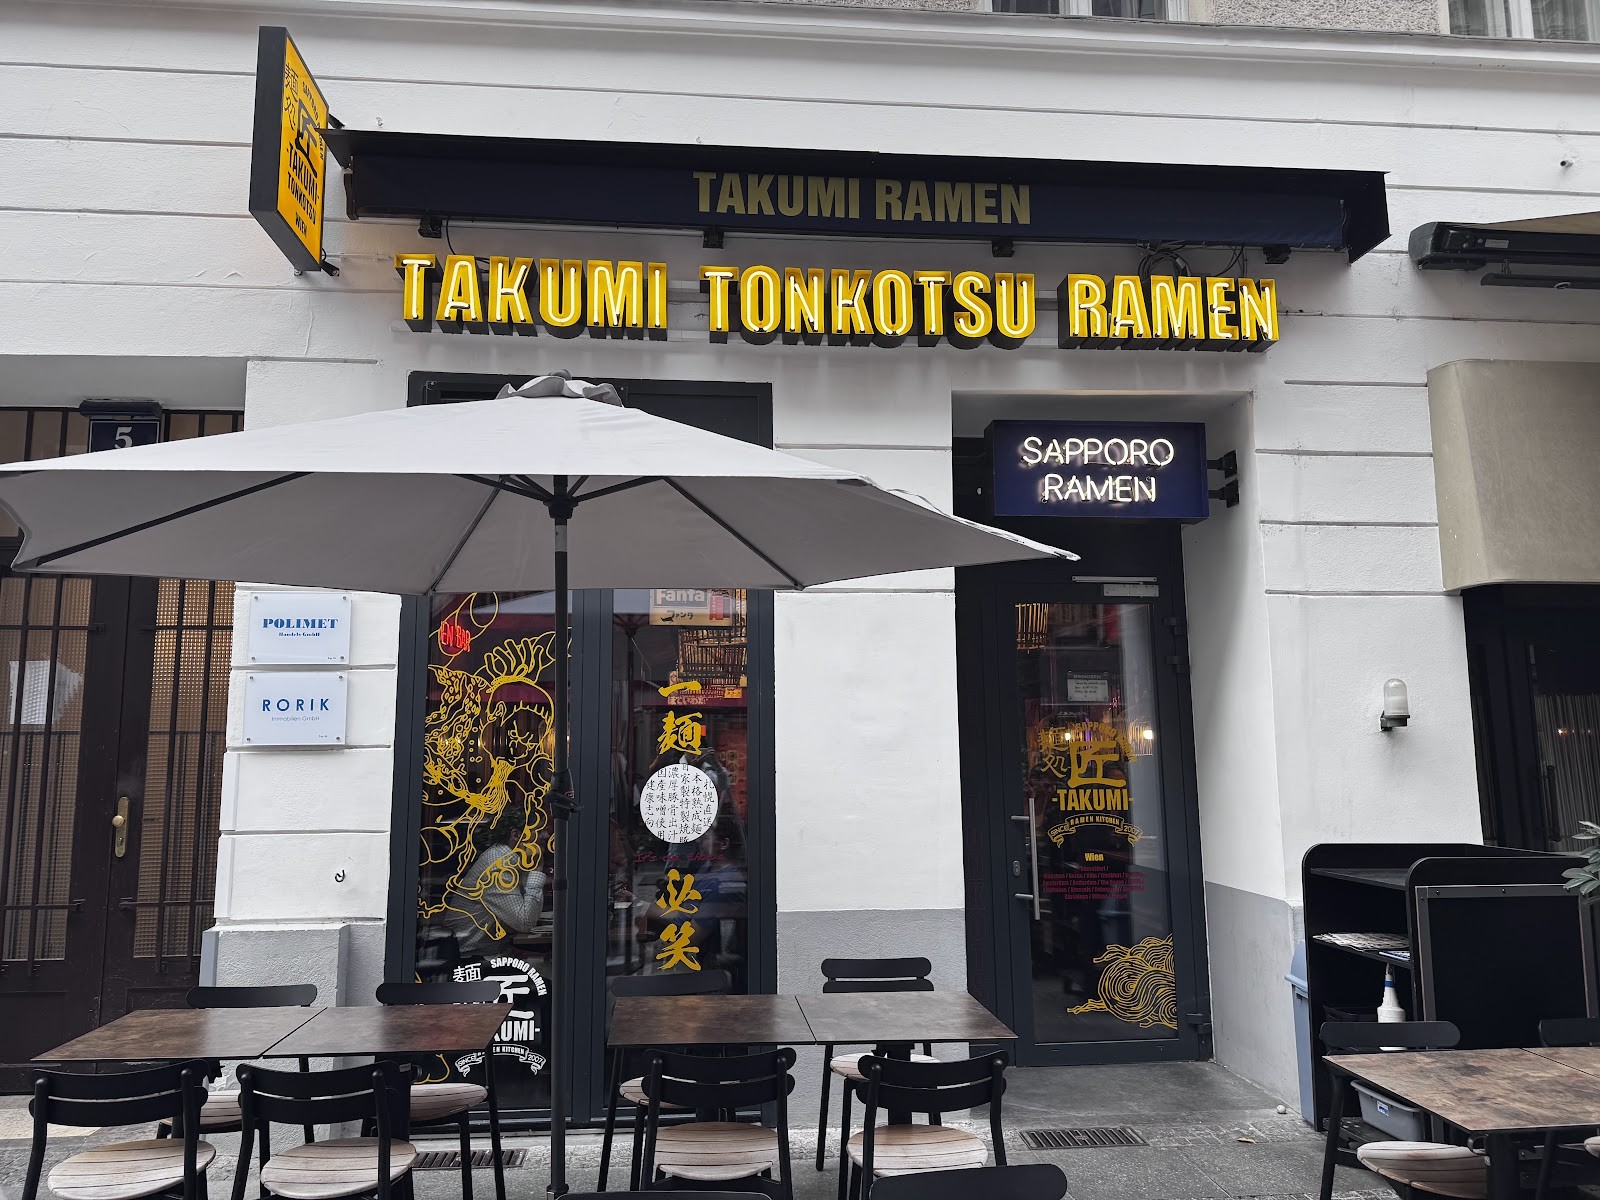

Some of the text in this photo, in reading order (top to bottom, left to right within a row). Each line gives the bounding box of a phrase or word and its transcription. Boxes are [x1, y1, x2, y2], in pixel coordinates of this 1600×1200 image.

[288, 171, 316, 225] TONKOTSU
[693, 171, 1031, 225] TAKUMI RAMEN
[394, 253, 1280, 341] TAKUMI TONKOTSU RAMEN
[114, 426, 133, 449] 5
[1020, 436, 1175, 467] SAPPORO
[1043, 473, 1157, 502] RAMEN
[656, 589, 705, 604] Fanta
[262, 618, 338, 629] POLIMET
[262, 698, 330, 712] RORIK
[656, 680, 703, 755] 一麺
[1067, 740, 1127, 788] 匠
[1070, 816, 1094, 825] RAMEN
[1095, 815, 1120, 825] KITCHEN
[1084, 852, 1105, 861] Wien
[656, 868, 703, 971] 必笑
[490, 957, 548, 996] SAPPORO RAMEN
[458, 1054, 476, 1067] SINCE
[501, 1045, 525, 1055] KITCHEN
[527, 1054, 543, 1064] 2007
